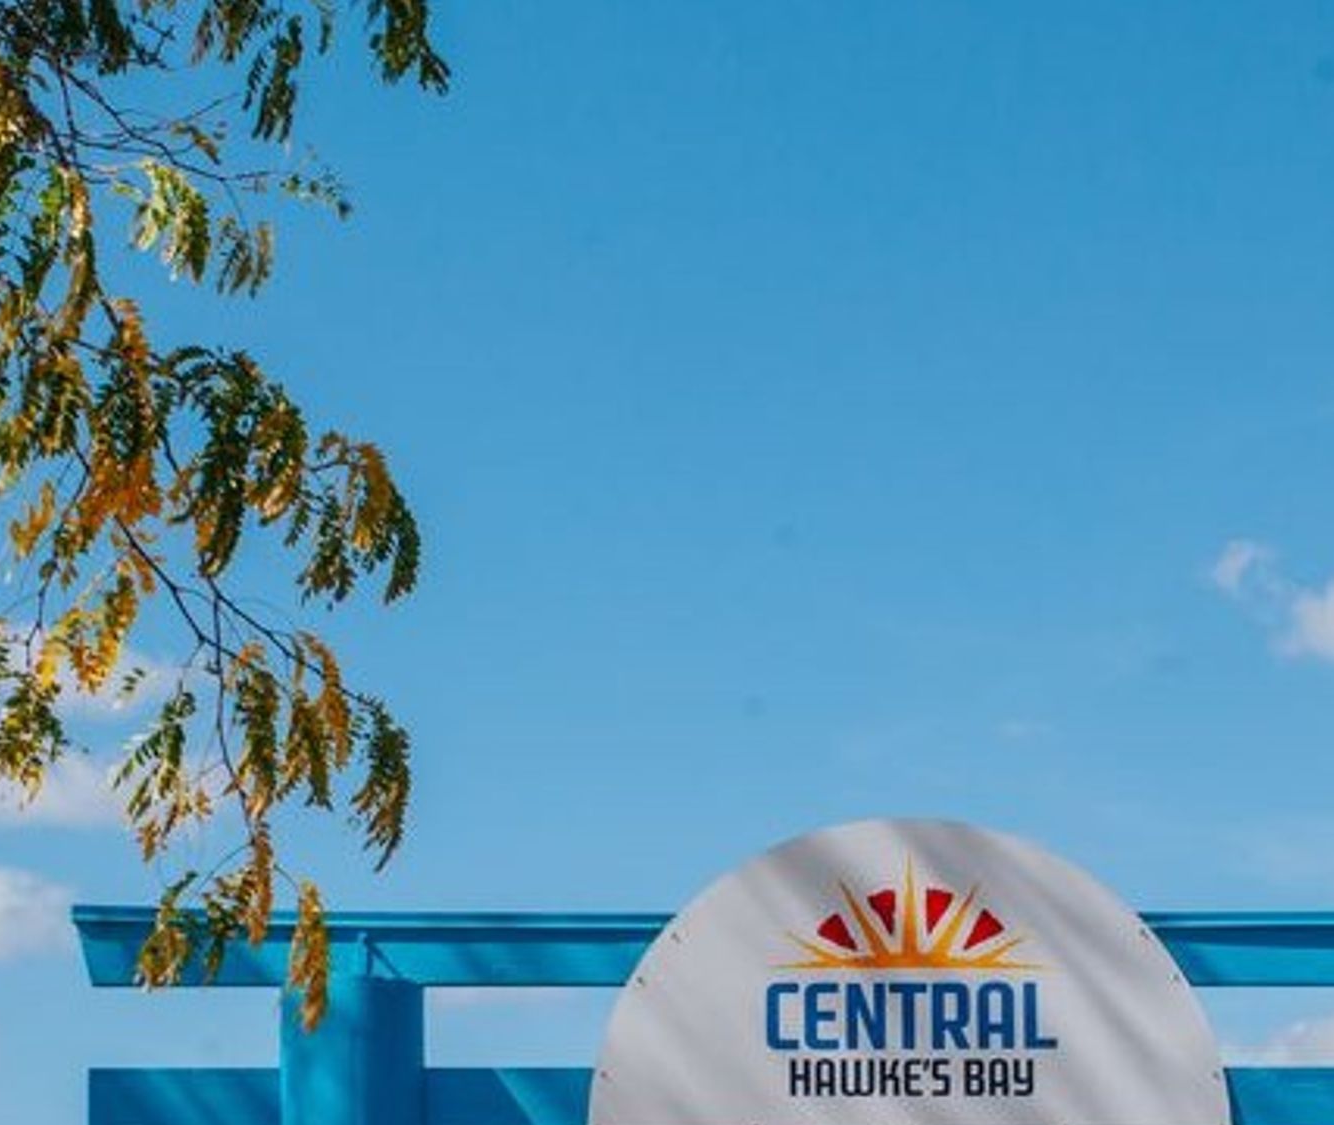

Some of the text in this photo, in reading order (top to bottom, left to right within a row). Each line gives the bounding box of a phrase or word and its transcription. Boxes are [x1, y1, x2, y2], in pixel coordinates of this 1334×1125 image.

[766, 981, 1058, 1050] CENTRAL
[789, 1058, 1034, 1098] HAWKE'S BAY
